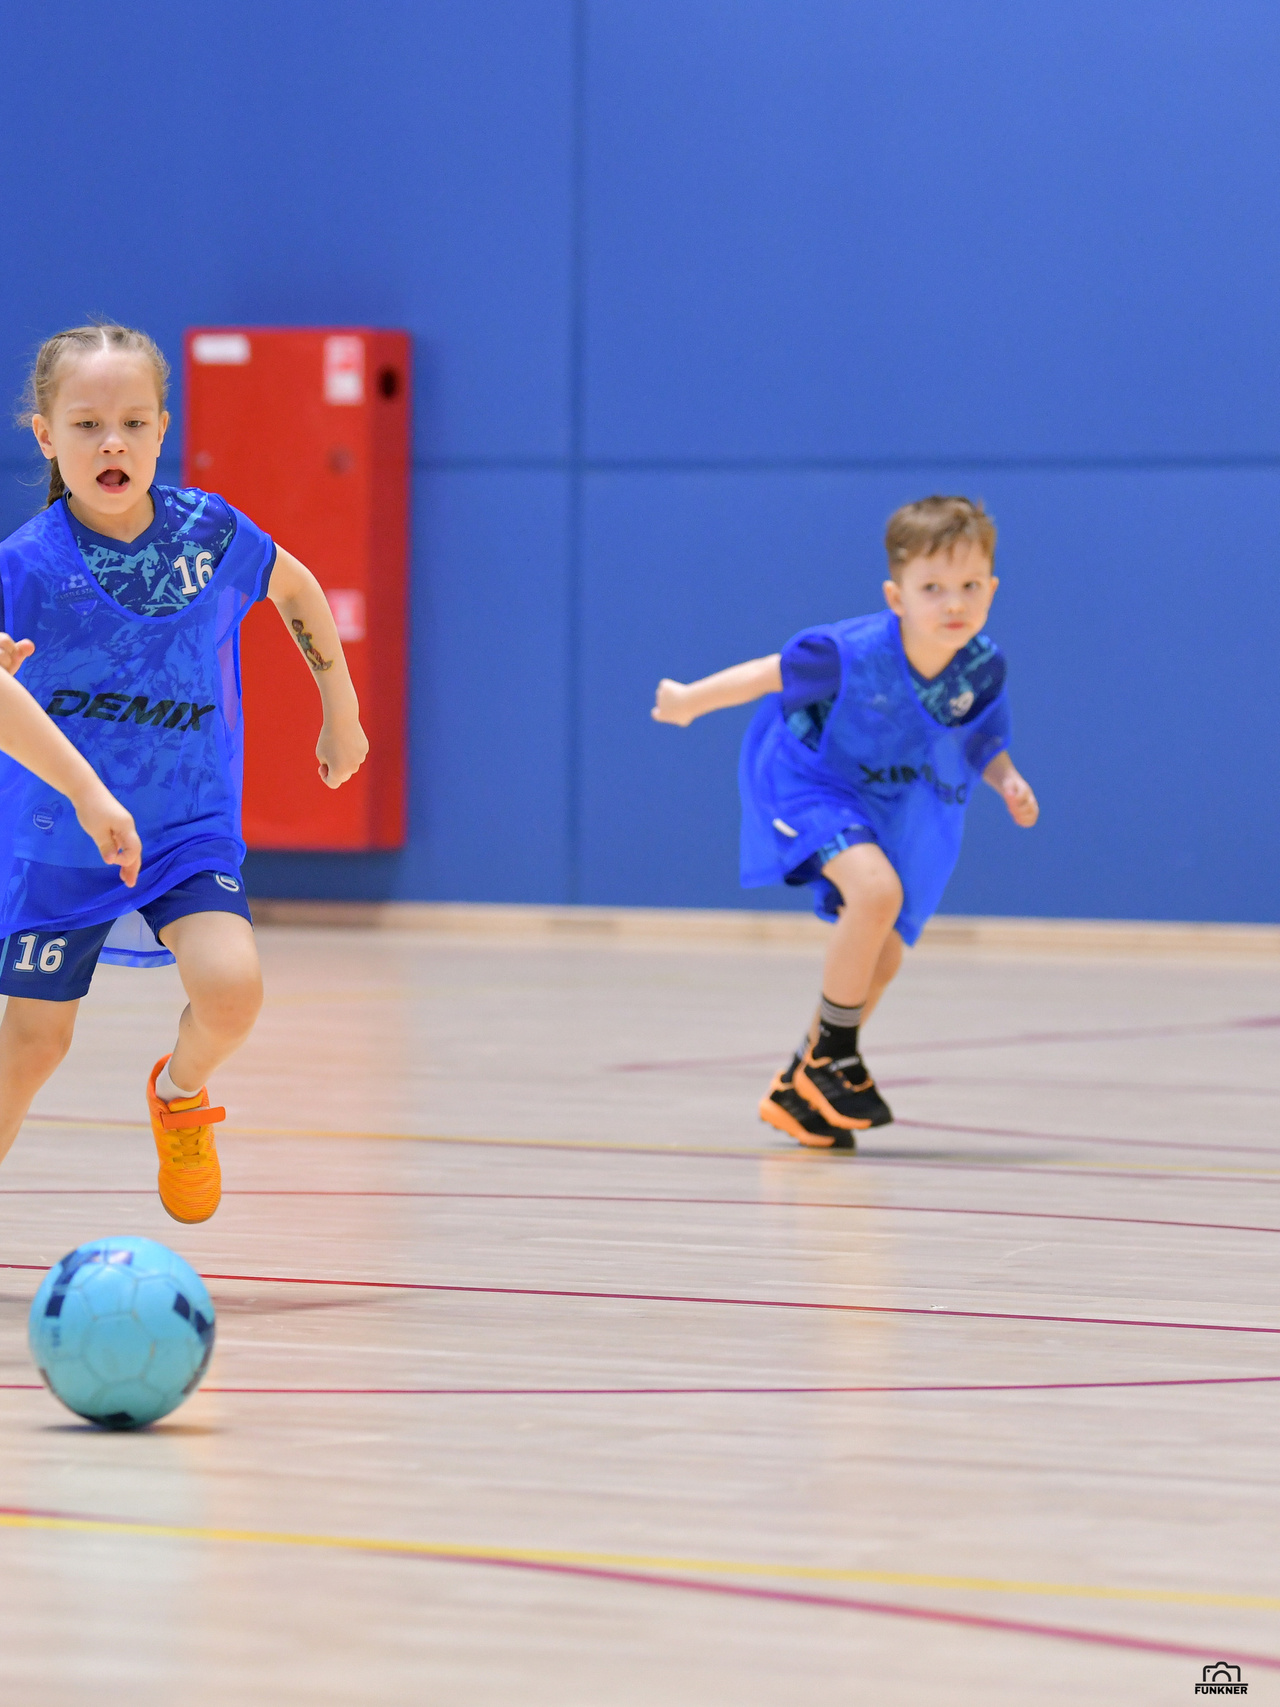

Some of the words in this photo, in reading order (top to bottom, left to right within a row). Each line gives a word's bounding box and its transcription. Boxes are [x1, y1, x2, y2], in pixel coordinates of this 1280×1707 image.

[174, 552, 213, 595] 16
[46, 689, 216, 732] DEMIX
[14, 934, 67, 973] 16
